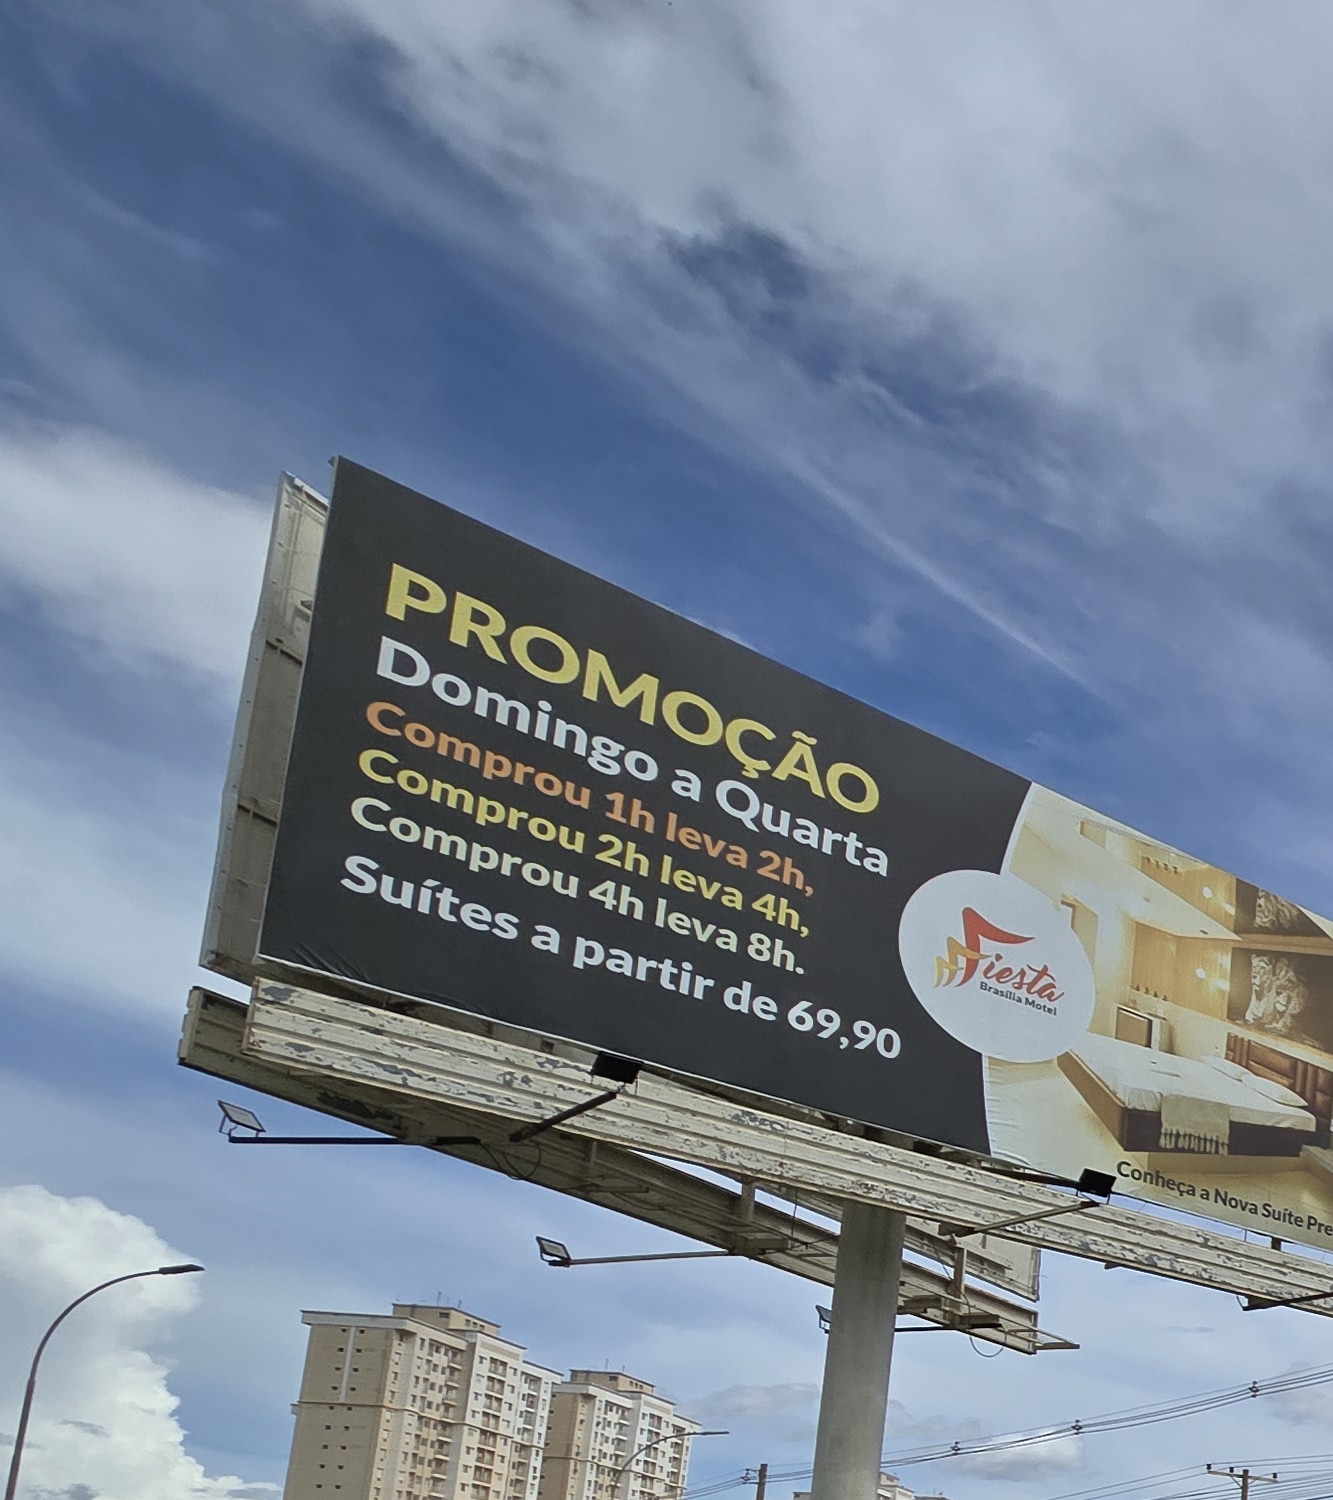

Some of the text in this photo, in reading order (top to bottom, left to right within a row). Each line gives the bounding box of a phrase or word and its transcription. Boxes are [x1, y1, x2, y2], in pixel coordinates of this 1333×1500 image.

[376, 635, 889, 877] Domingo a Quarta
[385, 562, 880, 814] PROMOÇÃO
[350, 796, 805, 975] Comprou 4h leva 8h.
[358, 748, 810, 938] Comprou 2h leva 4h,
[366, 701, 815, 897] Comprou 1h leva 2h,
[339, 855, 902, 1060] Suítes a partir de 69,90
[954, 906, 1065, 1002] Fiesta
[979, 980, 1058, 1016] Brasília Motel
[1116, 1160, 1196, 1198] Conheça
[1200, 1188, 1211, 1201] a
[1213, 1187, 1259, 1216] Nova
[1261, 1202, 1304, 1228] Suíte
